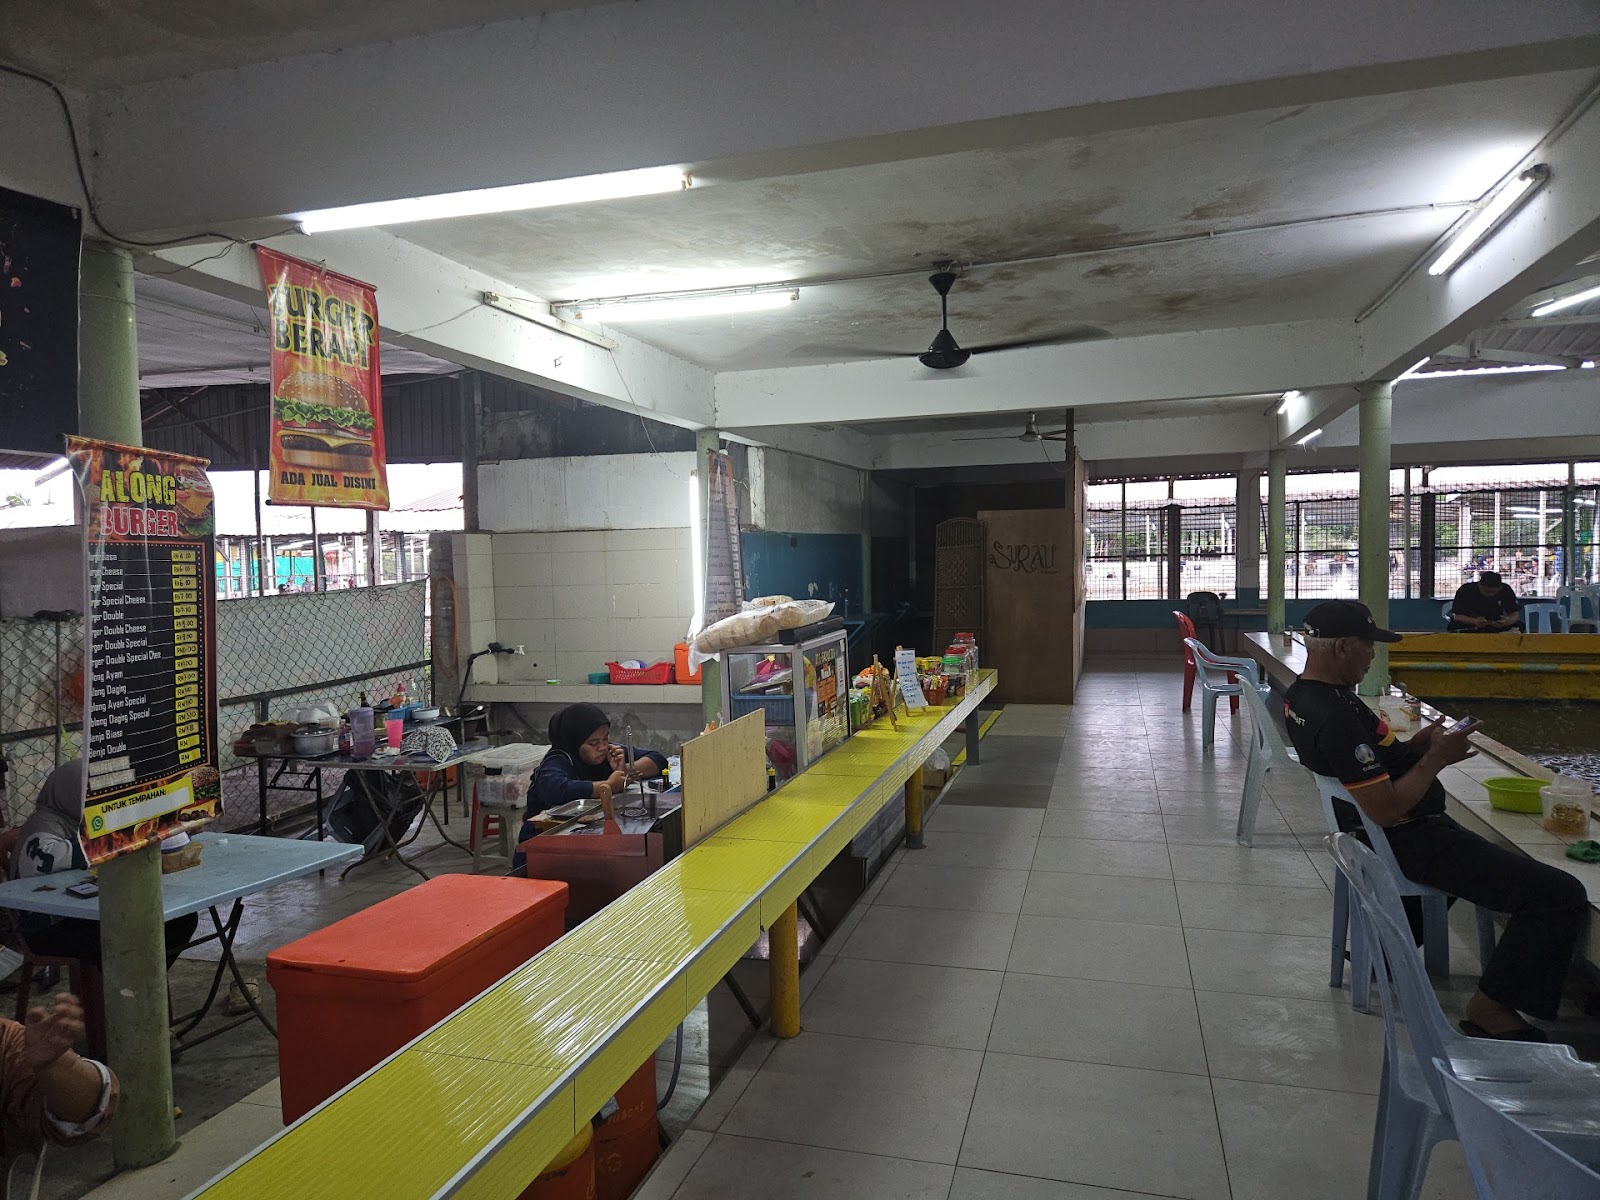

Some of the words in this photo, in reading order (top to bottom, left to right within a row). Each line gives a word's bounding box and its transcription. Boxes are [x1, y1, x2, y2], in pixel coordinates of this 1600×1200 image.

[275, 317, 369, 369] BERAPI
[100, 469, 176, 506] ALONG
[281, 471, 306, 486] ADA
[311, 473, 338, 488] JUAL
[343, 475, 376, 490] DISINI
[100, 506, 179, 537] BURGER
[991, 540, 1058, 574] SURAU
[101, 581, 124, 593] Special
[102, 596, 124, 608] Special
[125, 594, 146, 605] Cheese
[103, 610, 124, 621] Double
[104, 625, 125, 636] Double
[125, 623, 147, 634] Cheese
[105, 639, 125, 651] Double
[125, 637, 148, 649] Special
[106, 654, 126, 665] Double
[126, 651, 148, 664] Special
[106, 670, 124, 681] Ayam
[106, 684, 127, 696] Daging
[108, 699, 124, 711] Ayam
[125, 694, 147, 708] Special
[109, 713, 128, 725] Daging
[129, 707, 151, 721] Special
[107, 742, 127, 755] Double
[101, 800, 128, 814] UNTUK
[128, 789, 167, 806] TEMPAHAN:
